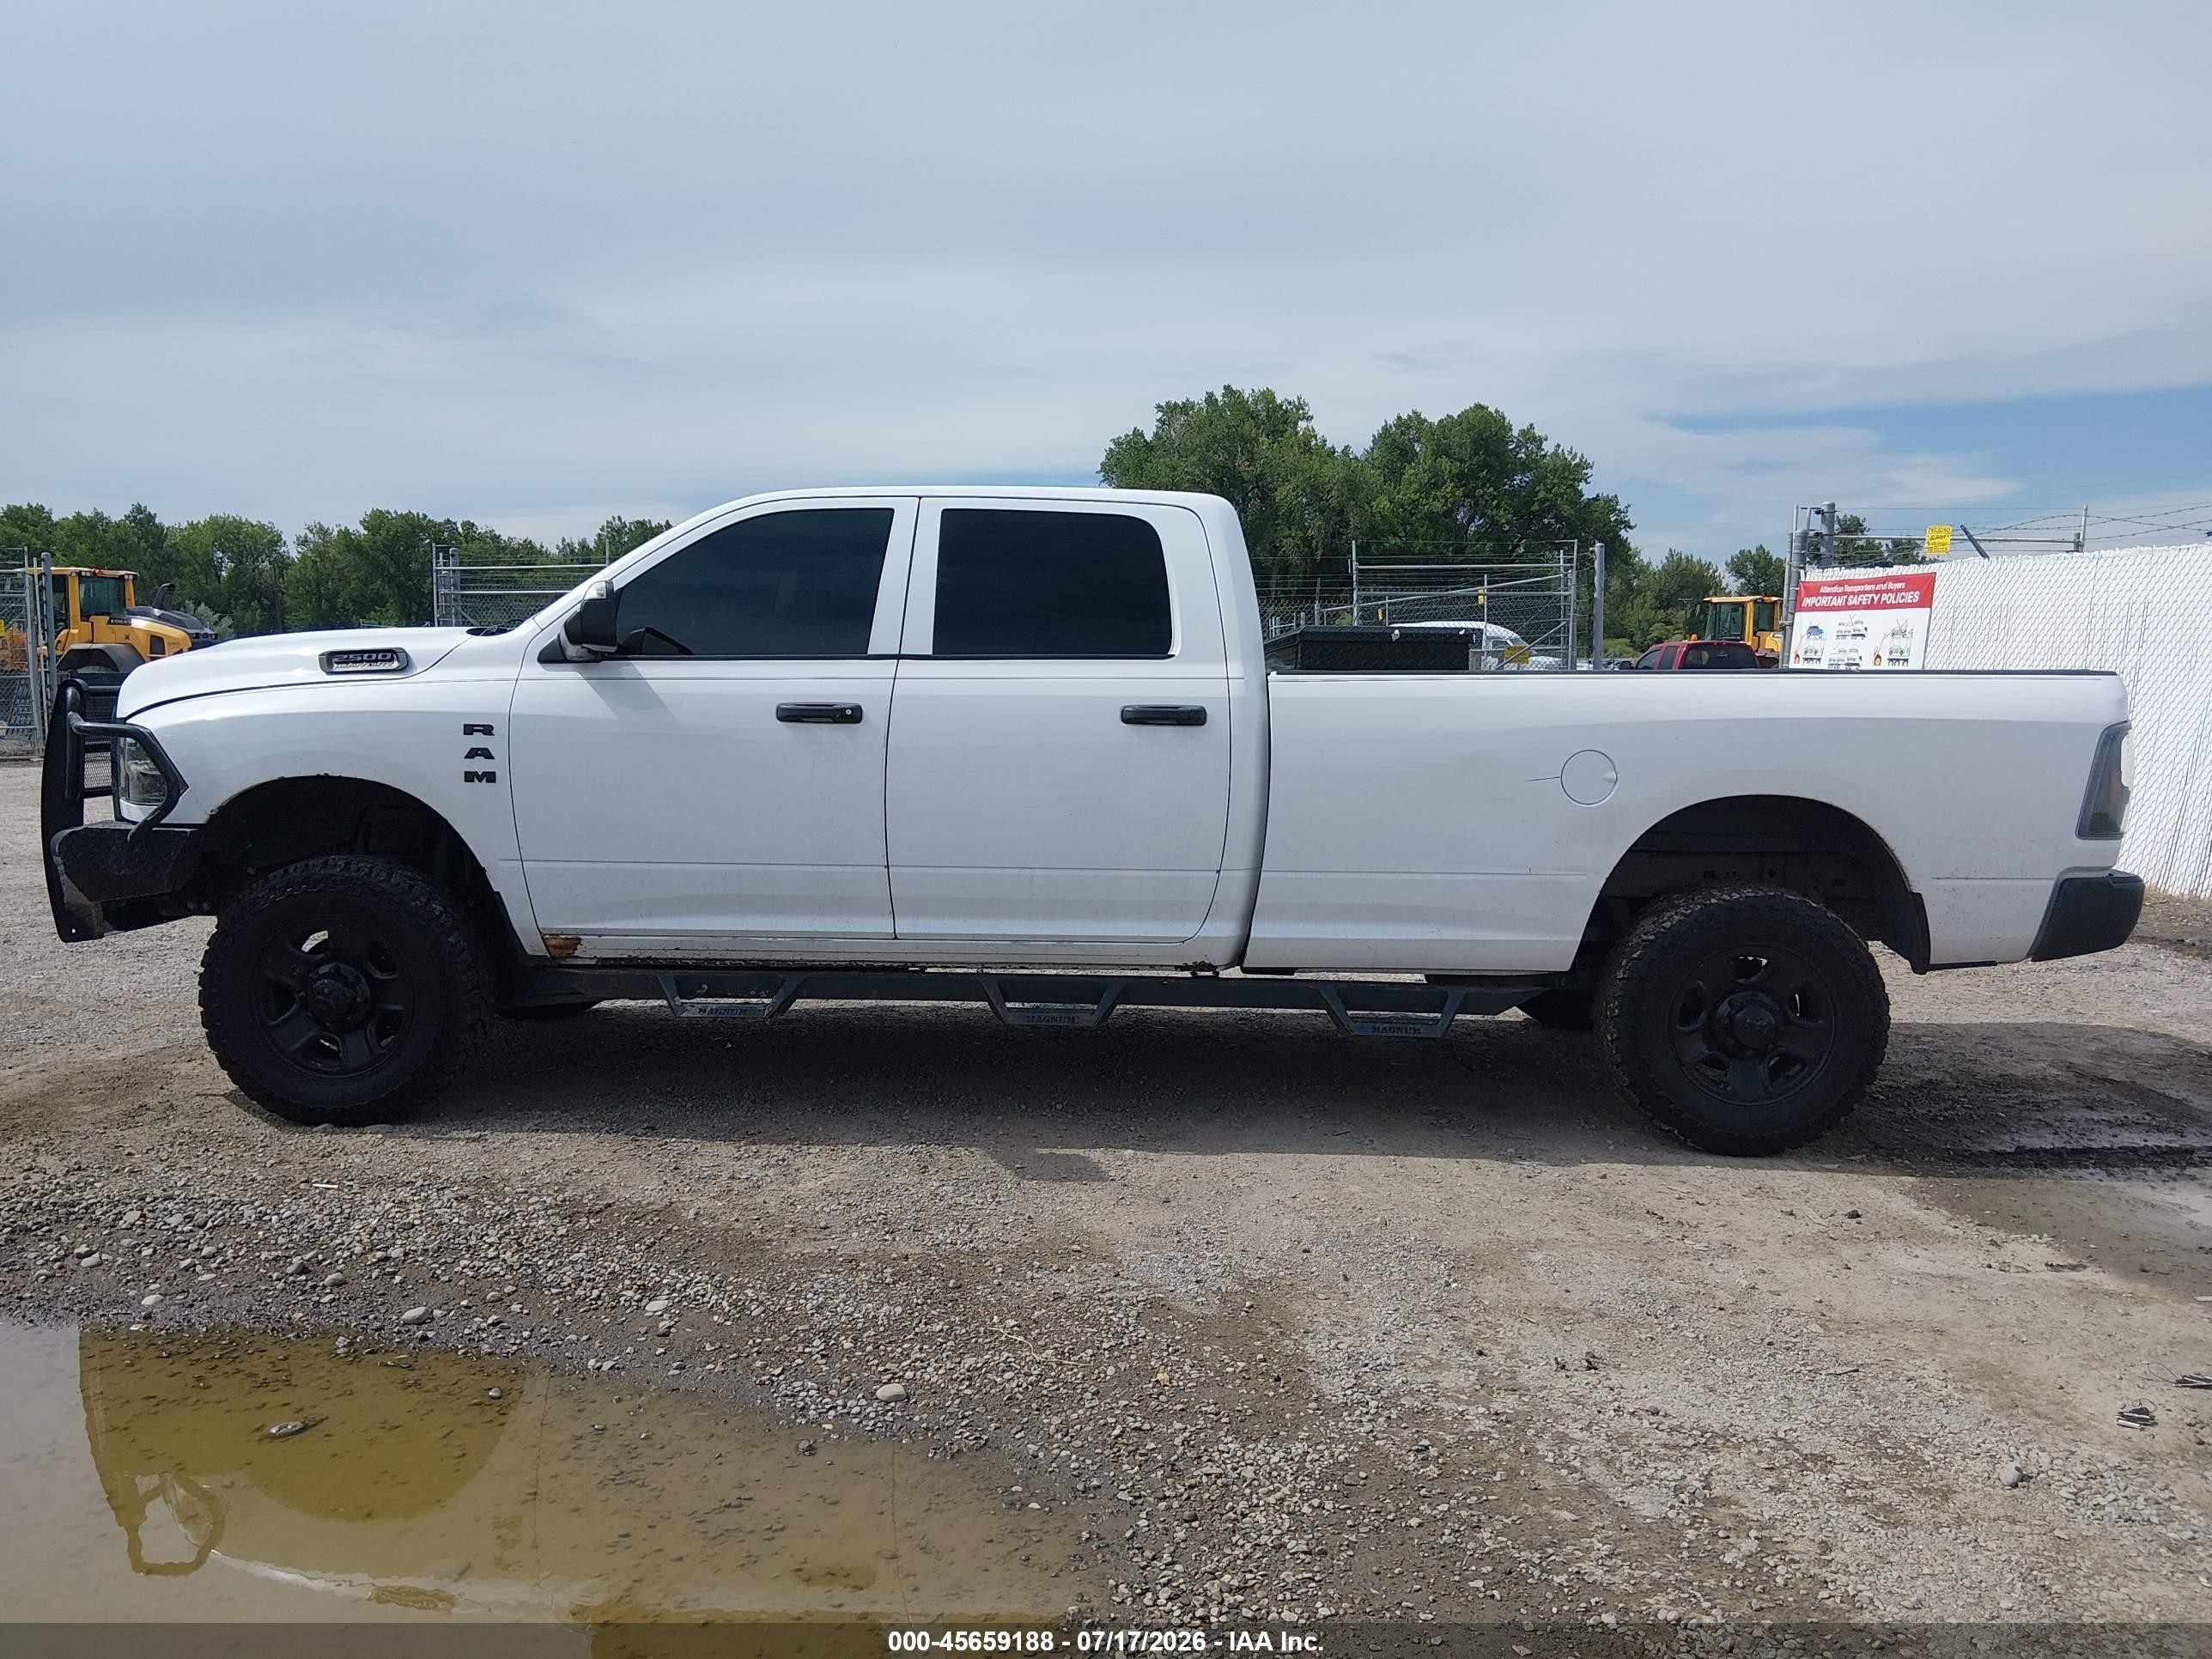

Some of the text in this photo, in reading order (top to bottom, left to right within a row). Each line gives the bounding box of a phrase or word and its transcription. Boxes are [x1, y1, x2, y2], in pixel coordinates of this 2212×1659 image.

[1820, 581, 1906, 593] Attention Transporters and Buyers
[1802, 591, 1920, 607] IMPORTANT SAFETY POLICIES
[333, 653, 392, 662] 2500
[463, 724, 496, 783] RAM
[1026, 1016, 1077, 1024] MAGNUM
